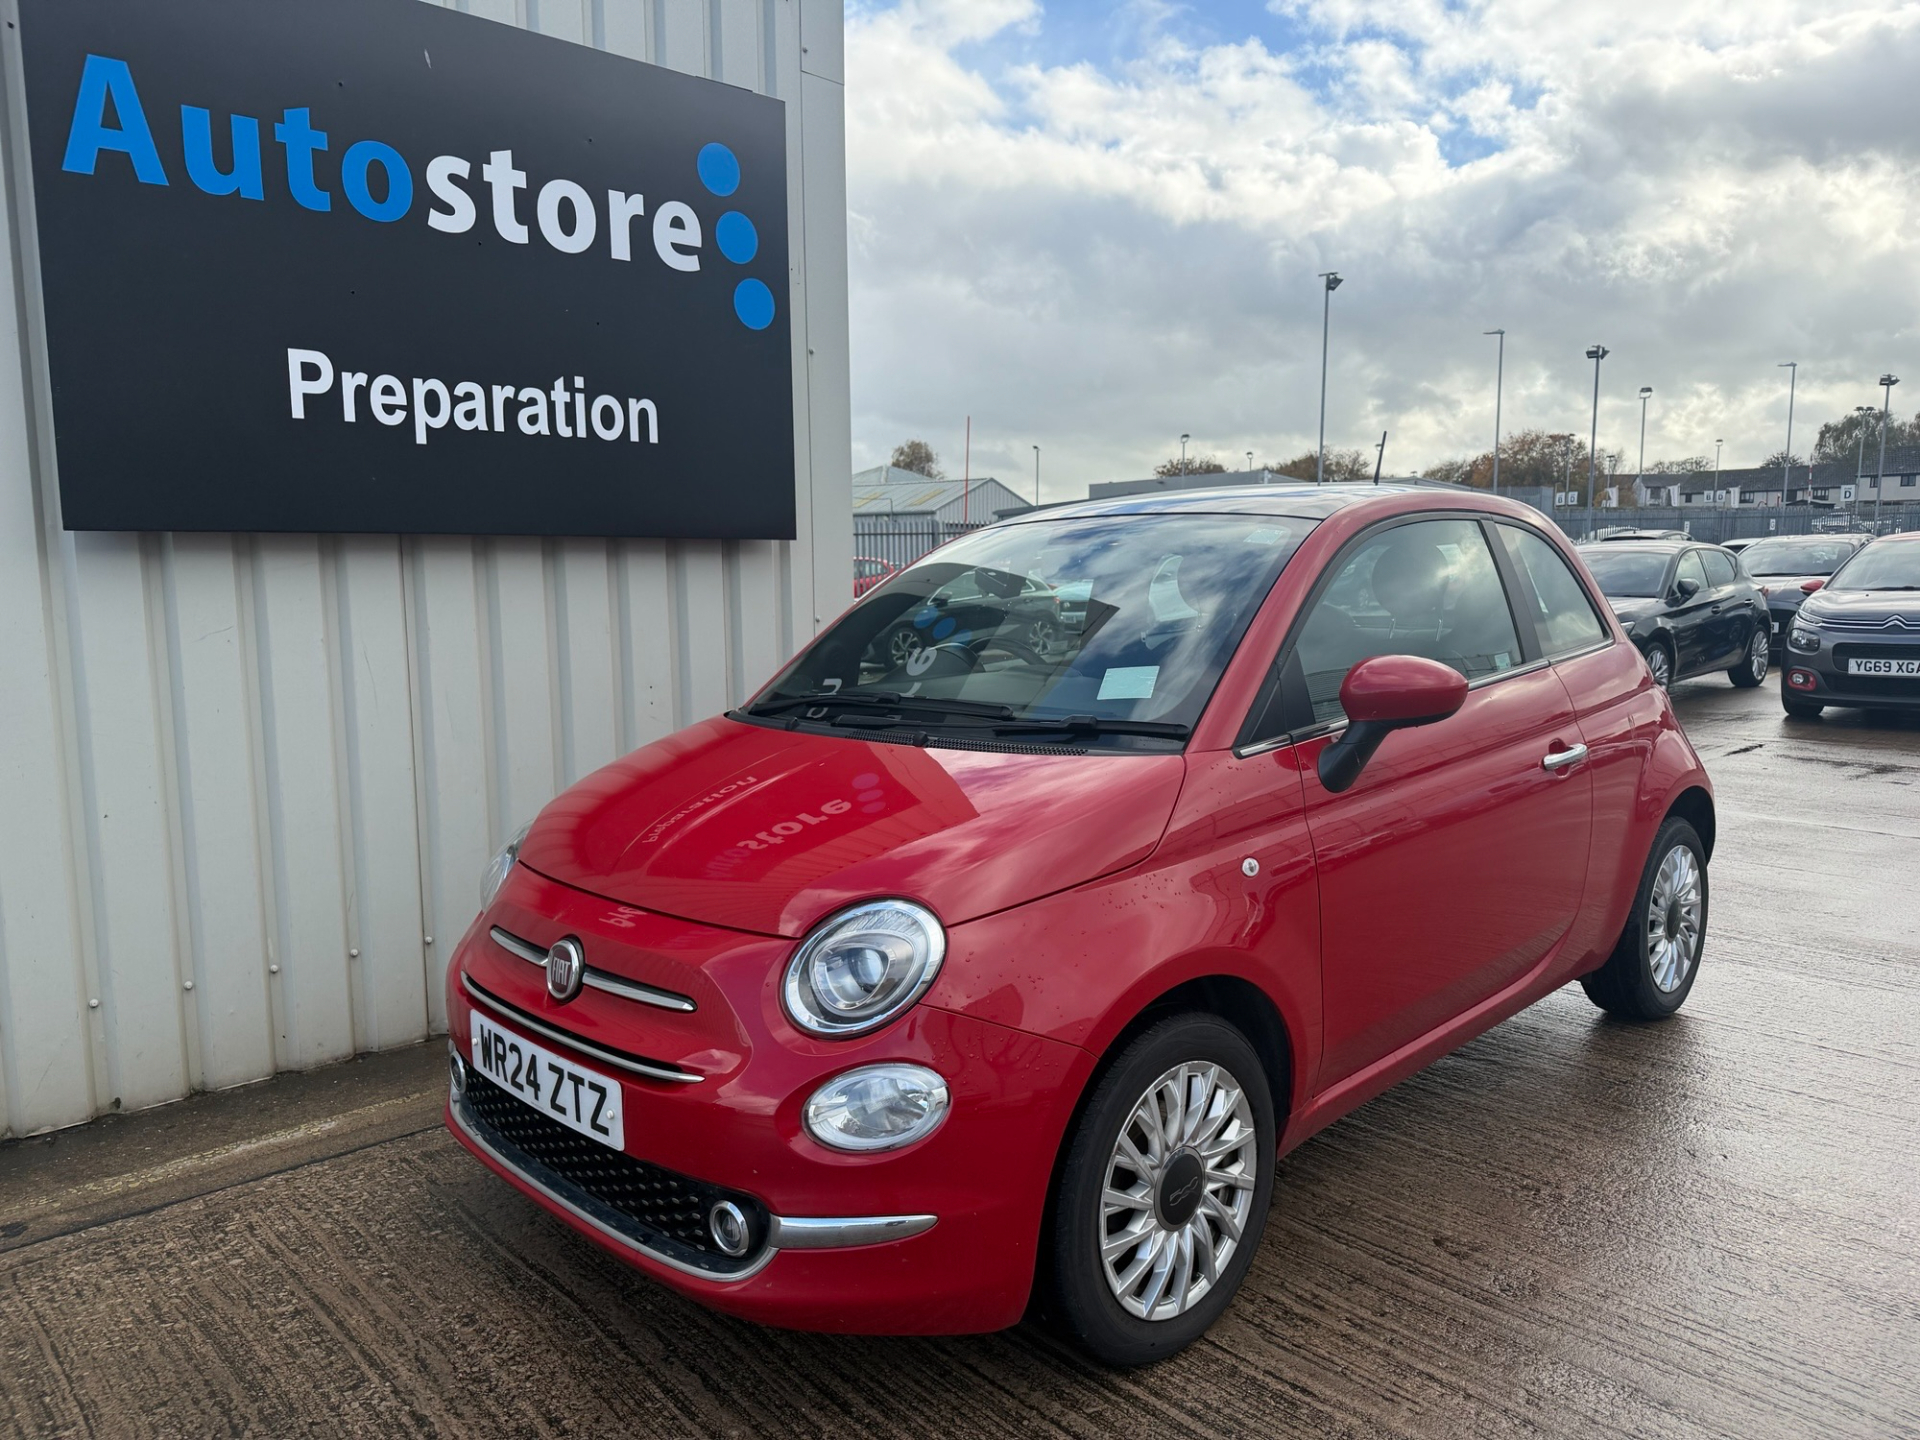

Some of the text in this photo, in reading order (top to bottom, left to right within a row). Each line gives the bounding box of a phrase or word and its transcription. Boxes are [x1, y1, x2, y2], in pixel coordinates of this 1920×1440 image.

[62, 54, 703, 272] Autostore
[288, 348, 659, 445] Preparation
[1855, 660, 1892, 673] YG69
[552, 956, 571, 986] FIAT
[480, 1024, 609, 1137] WR24 ZTZ
